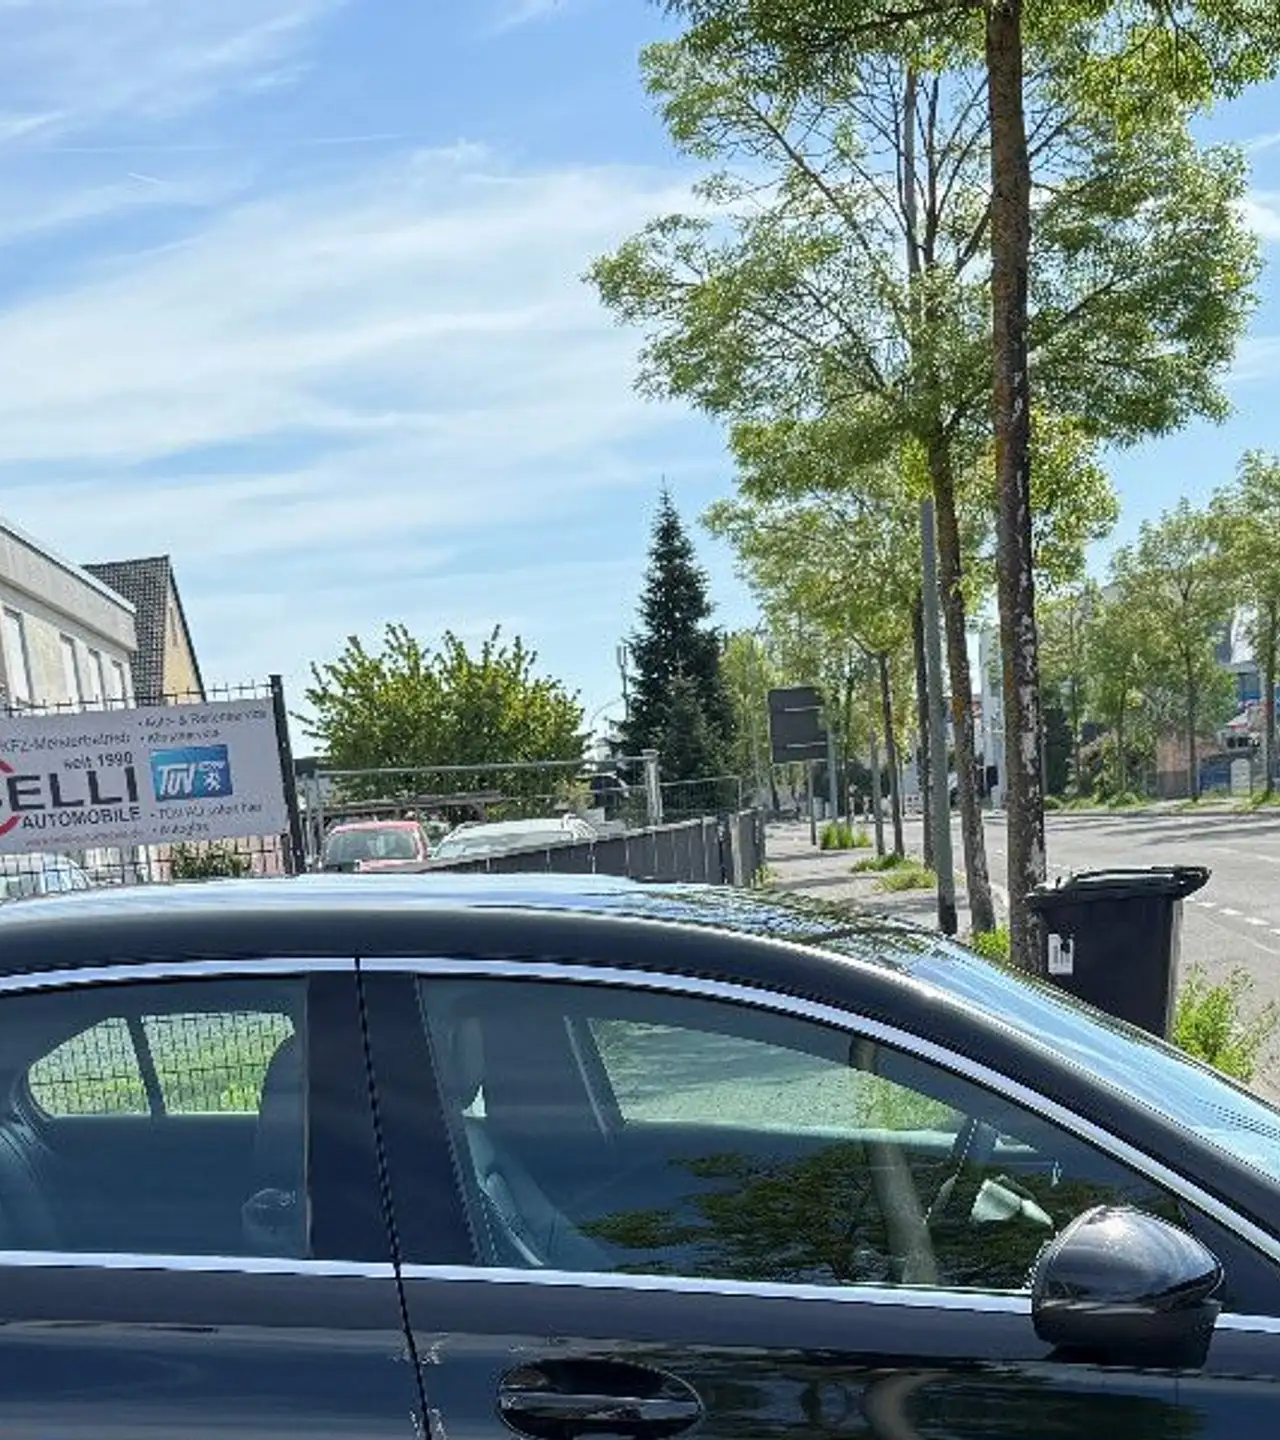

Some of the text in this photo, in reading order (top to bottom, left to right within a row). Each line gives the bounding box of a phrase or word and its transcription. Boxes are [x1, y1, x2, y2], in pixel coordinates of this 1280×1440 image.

[64, 751, 133, 770] seit 1990
[22, 806, 141, 830] AUTOMOBILE
